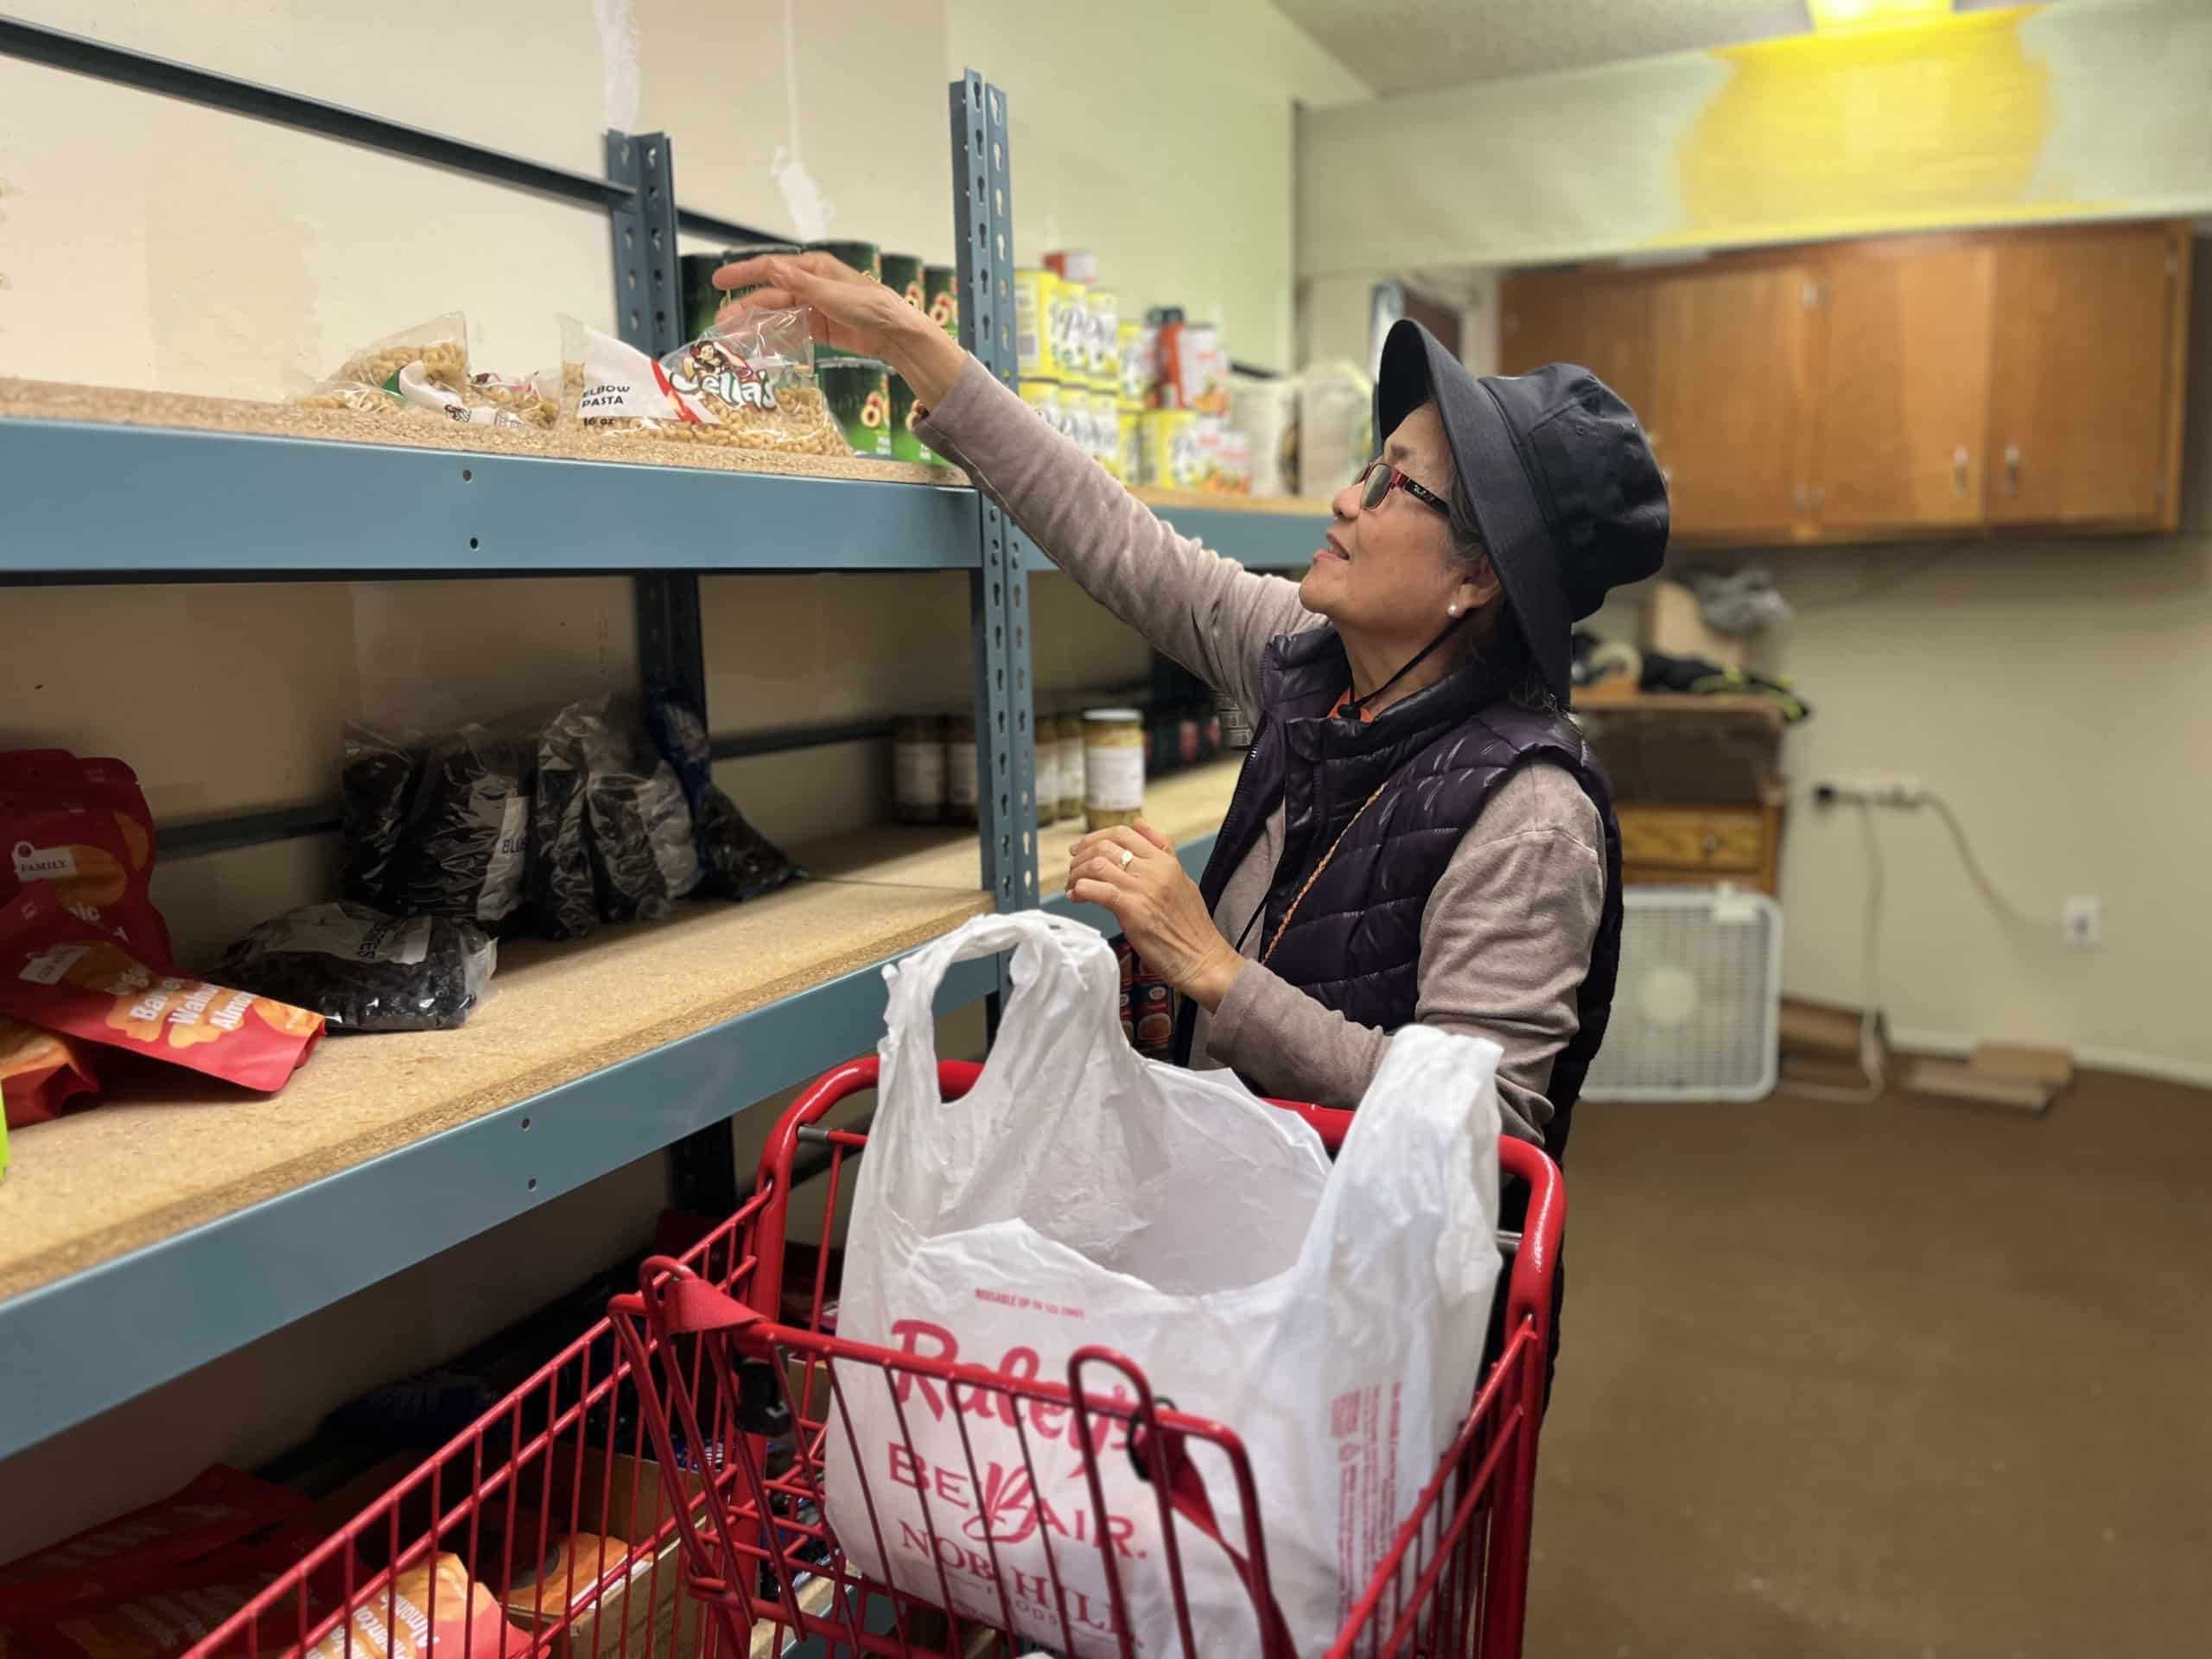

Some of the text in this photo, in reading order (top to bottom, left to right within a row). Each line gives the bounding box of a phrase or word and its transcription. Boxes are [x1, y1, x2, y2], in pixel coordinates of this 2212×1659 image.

[582, 385, 630, 398] ELBOW
[582, 395, 624, 408] PASTA
[583, 416, 595, 427] 16
[21, 859, 67, 873] FAMILY
